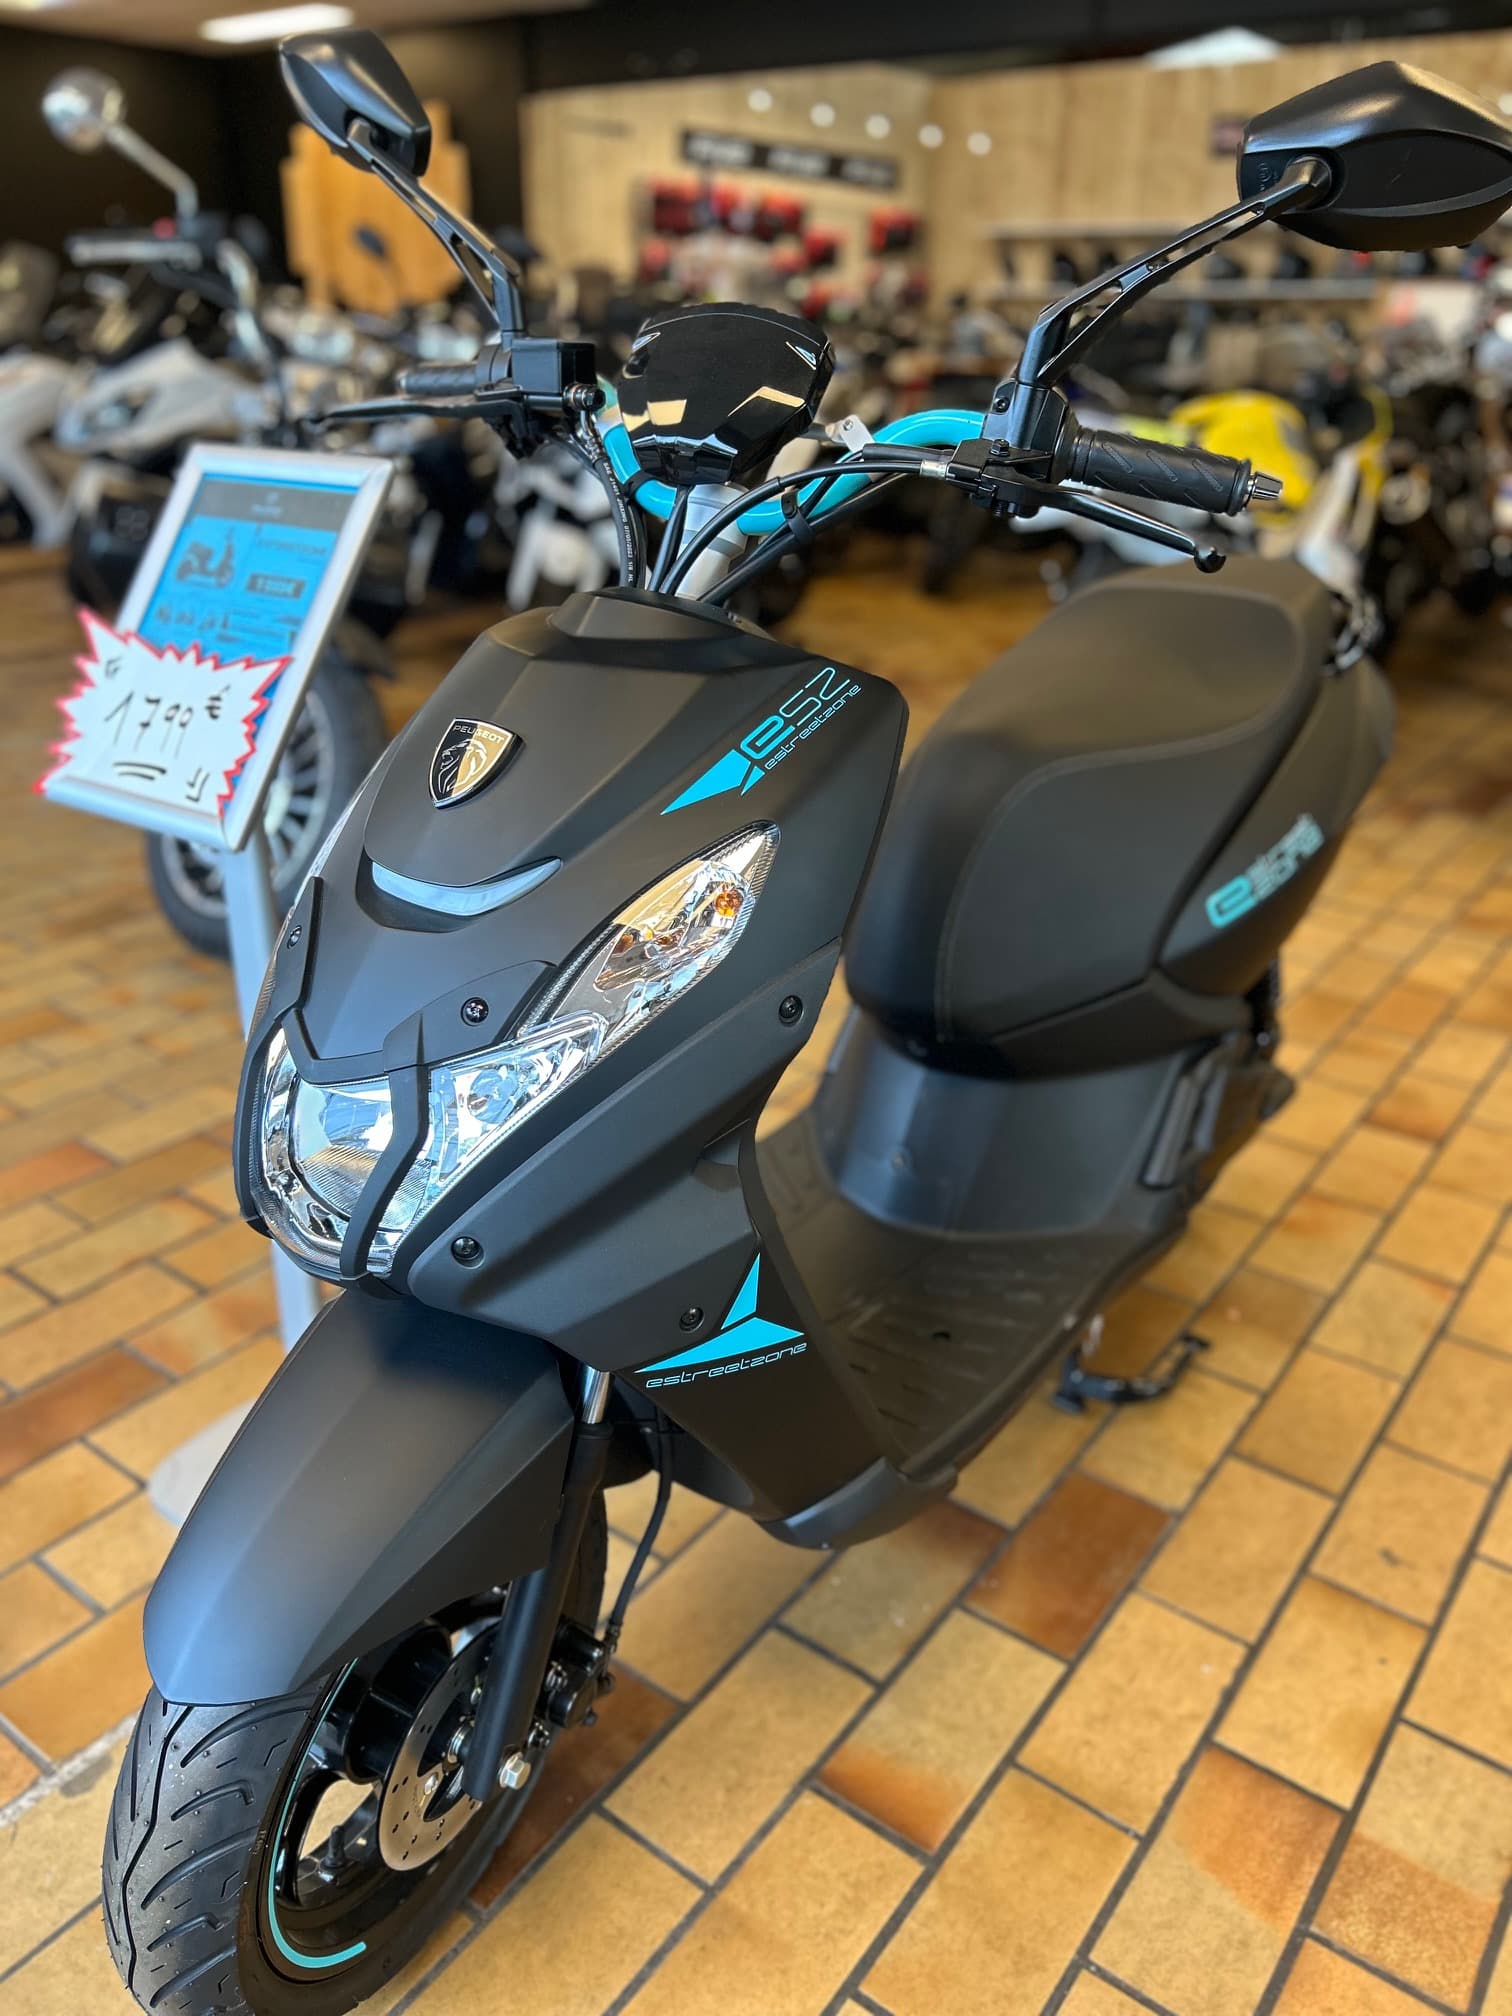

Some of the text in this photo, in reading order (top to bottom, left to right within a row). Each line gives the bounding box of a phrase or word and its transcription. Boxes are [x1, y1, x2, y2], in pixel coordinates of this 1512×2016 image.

[453, 725, 505, 744] PEUGEOT
[764, 684, 862, 770] estreetzone
[645, 1342, 808, 1388] estreetzone
